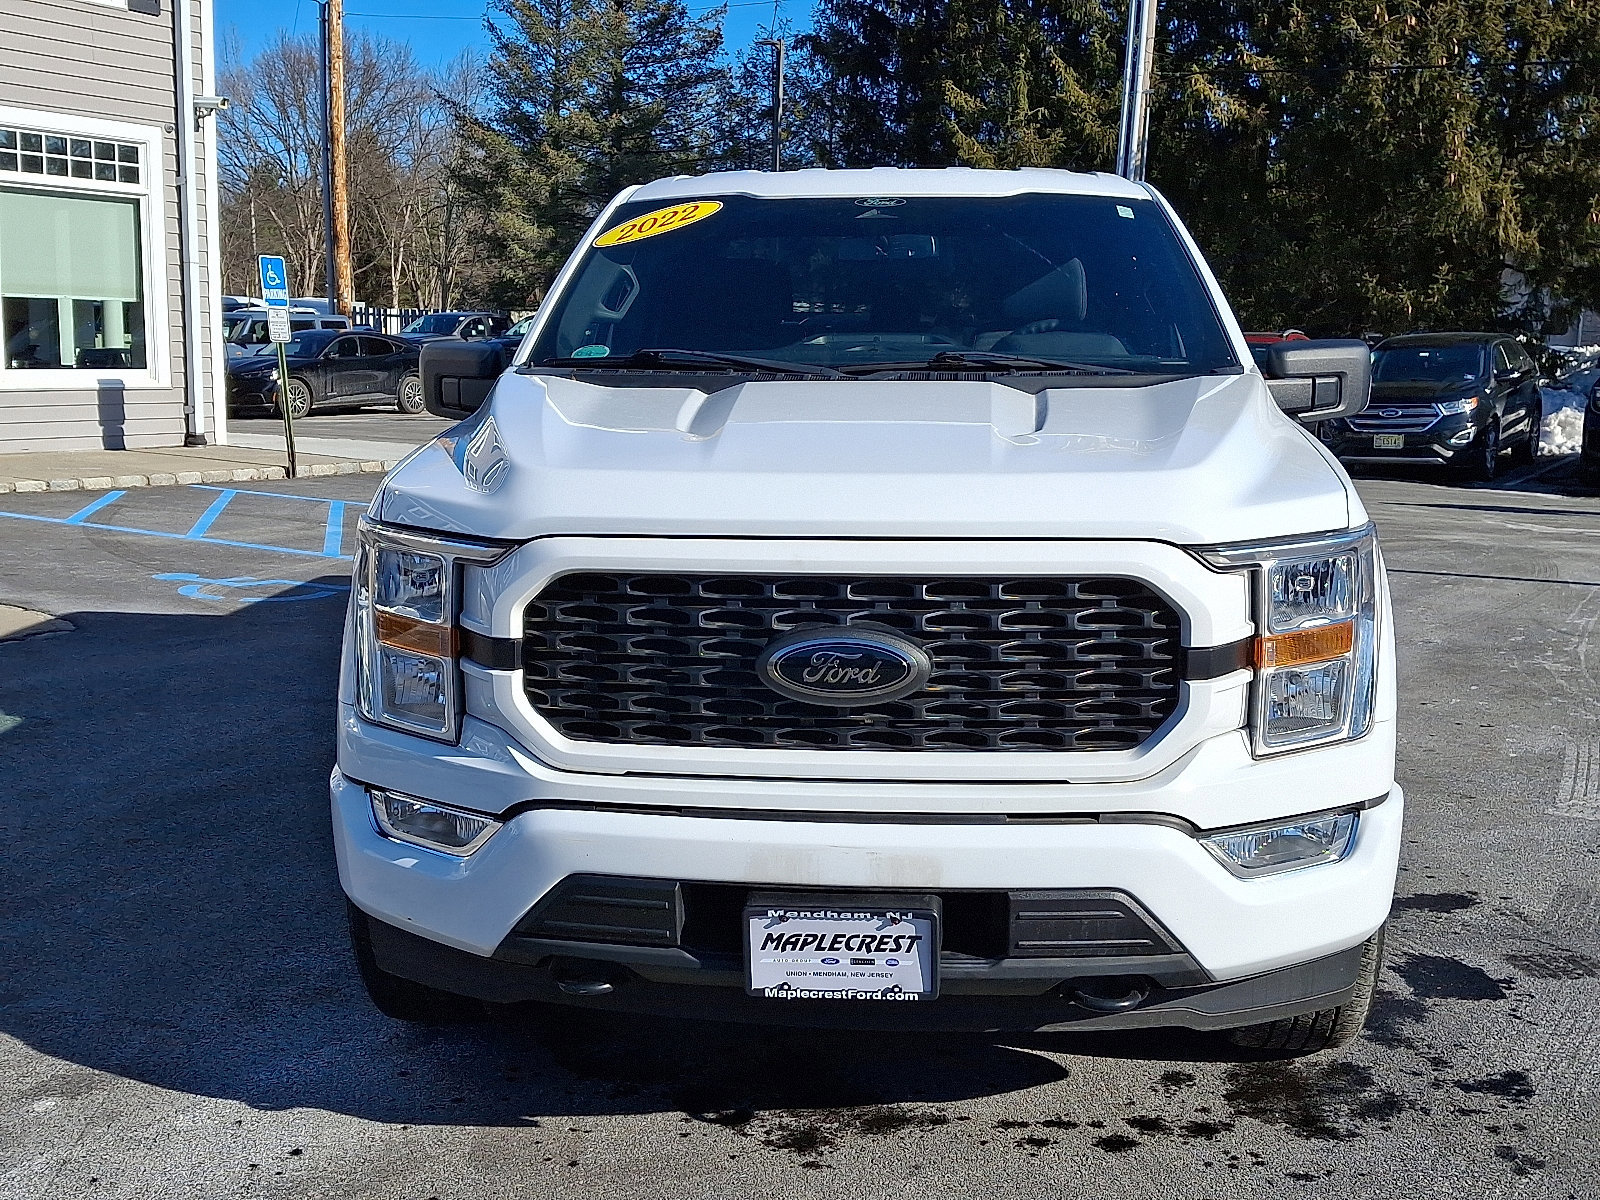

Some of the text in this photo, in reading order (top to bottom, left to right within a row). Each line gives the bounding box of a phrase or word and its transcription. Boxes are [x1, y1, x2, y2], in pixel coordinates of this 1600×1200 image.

[864, 198, 898, 206] Ford
[615, 205, 699, 242] 2022
[803, 651, 882, 684] Ford
[767, 909, 912, 921] Mendham, NJ
[760, 932, 923, 954] MAPLECREST
[764, 987, 919, 1001] MaplecrestFord.com
